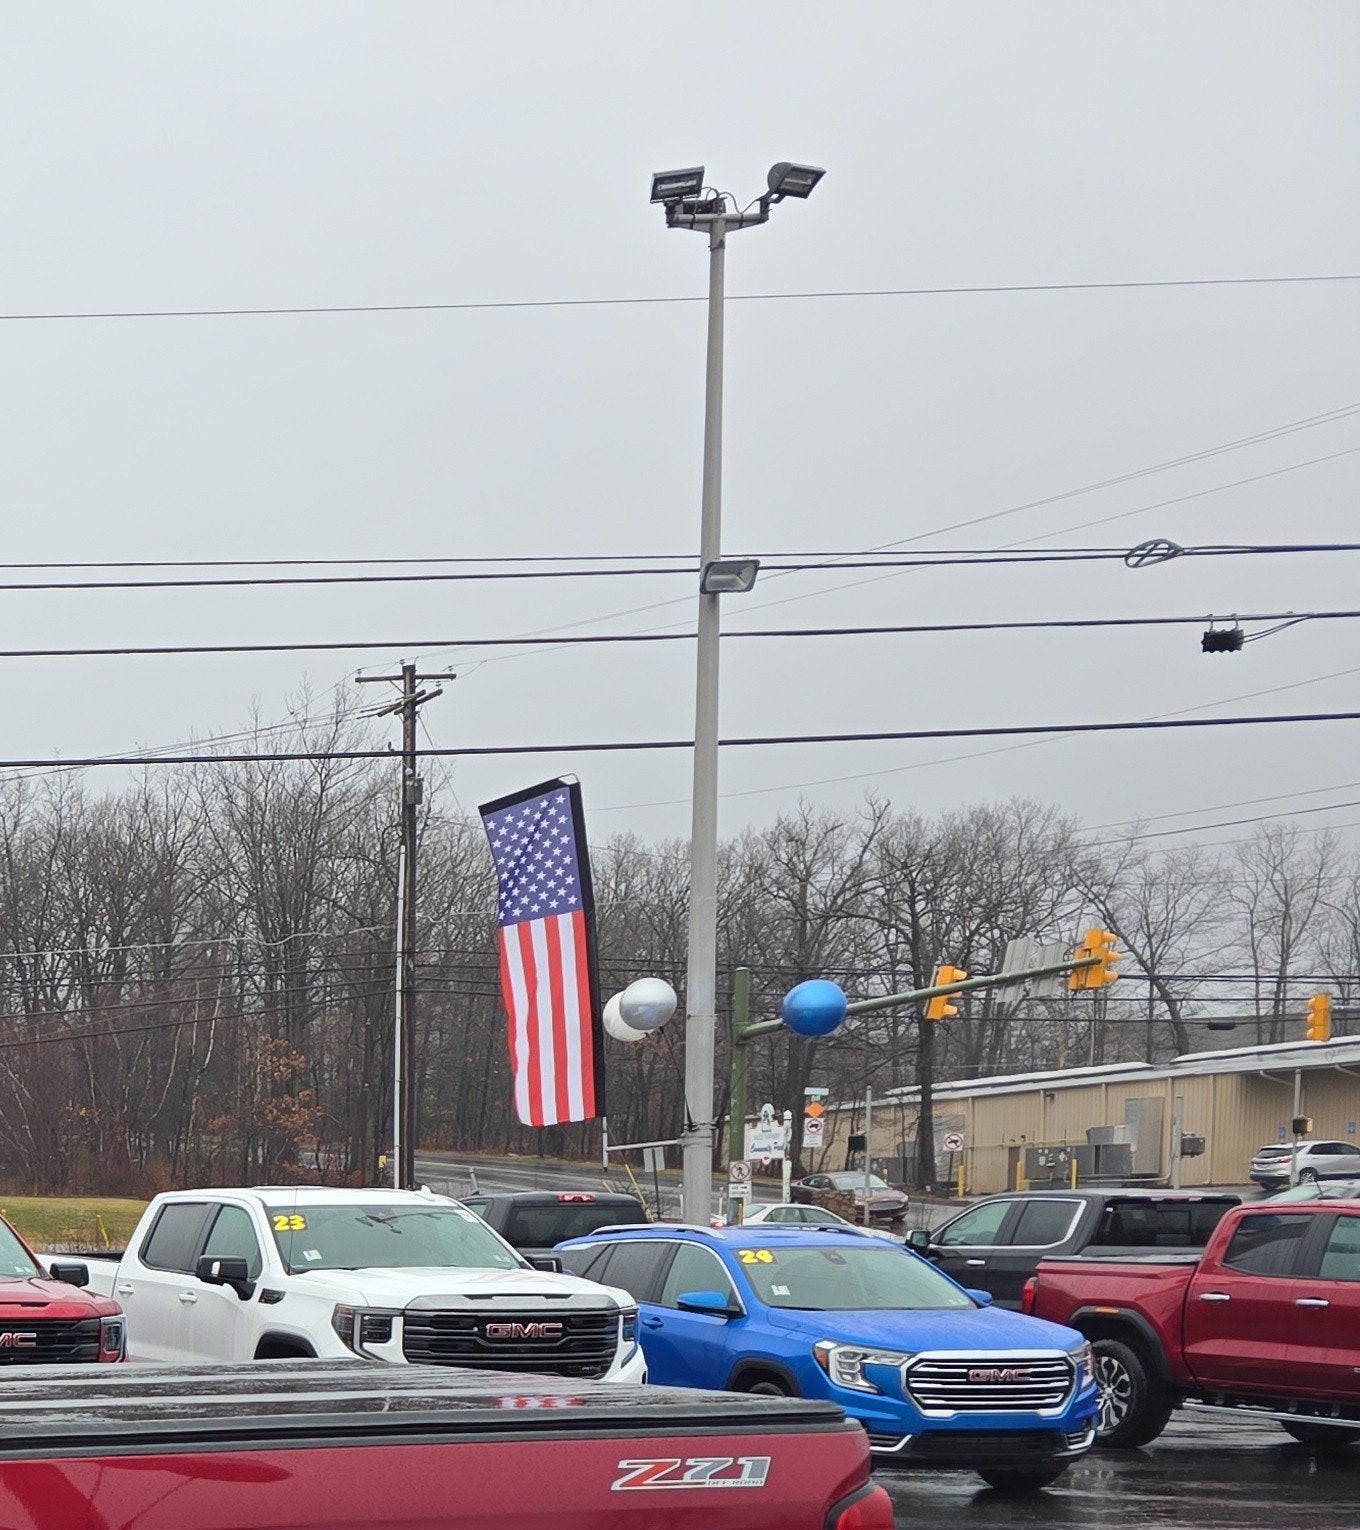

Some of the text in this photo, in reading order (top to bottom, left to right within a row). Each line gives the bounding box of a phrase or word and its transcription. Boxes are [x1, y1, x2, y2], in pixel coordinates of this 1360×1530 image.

[273, 1214, 306, 1231] 23
[738, 1249, 774, 1264] 24
[485, 1322, 564, 1339] GMC
[967, 1368, 1032, 1383] GMC
[610, 1455, 772, 1491] Z71
